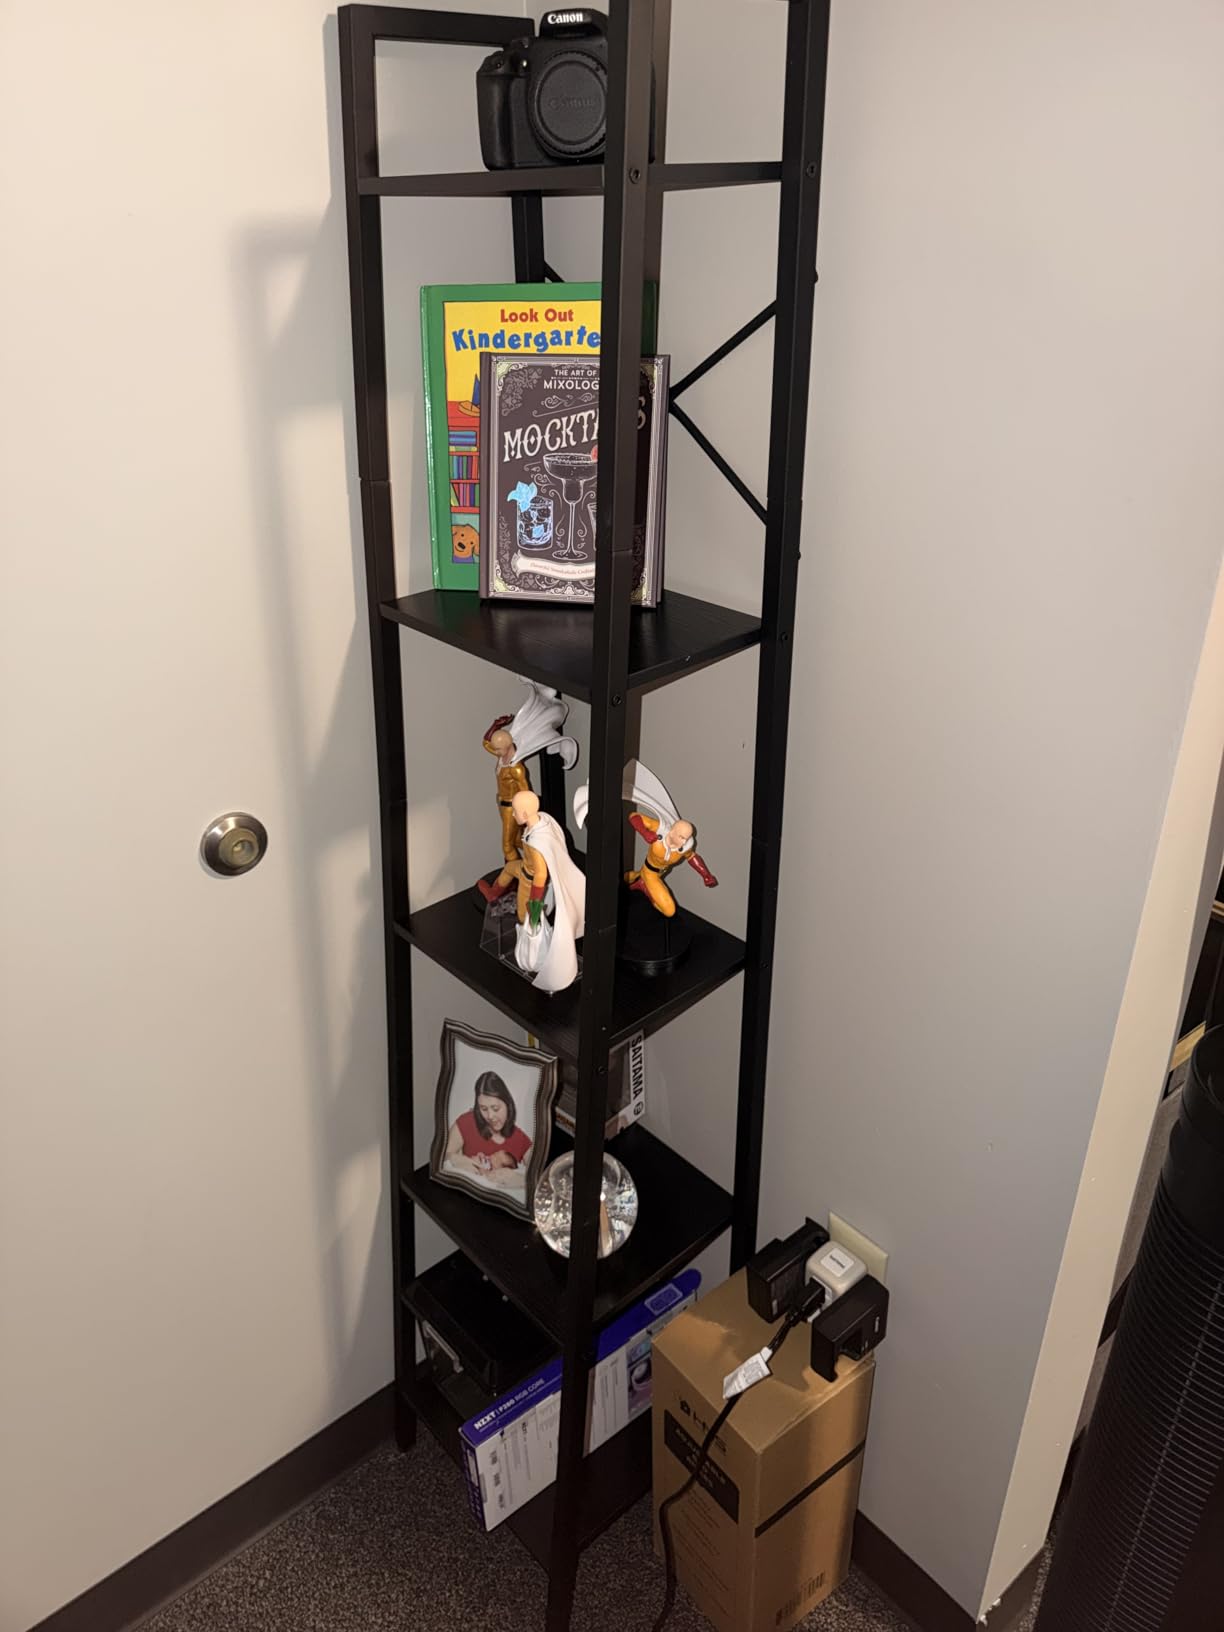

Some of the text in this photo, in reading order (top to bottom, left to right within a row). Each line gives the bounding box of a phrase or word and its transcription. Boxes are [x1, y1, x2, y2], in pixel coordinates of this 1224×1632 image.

[547, 12, 583, 25] Canon
[500, 308, 574, 323] Look Out
[451, 325, 601, 353] Kindergarte
[554, 369, 597, 377] THE ART OF
[544, 379, 599, 390] MIXOLOG
[631, 1034, 643, 1100] SAITAMA
[473, 1411, 497, 1430] NZXT
